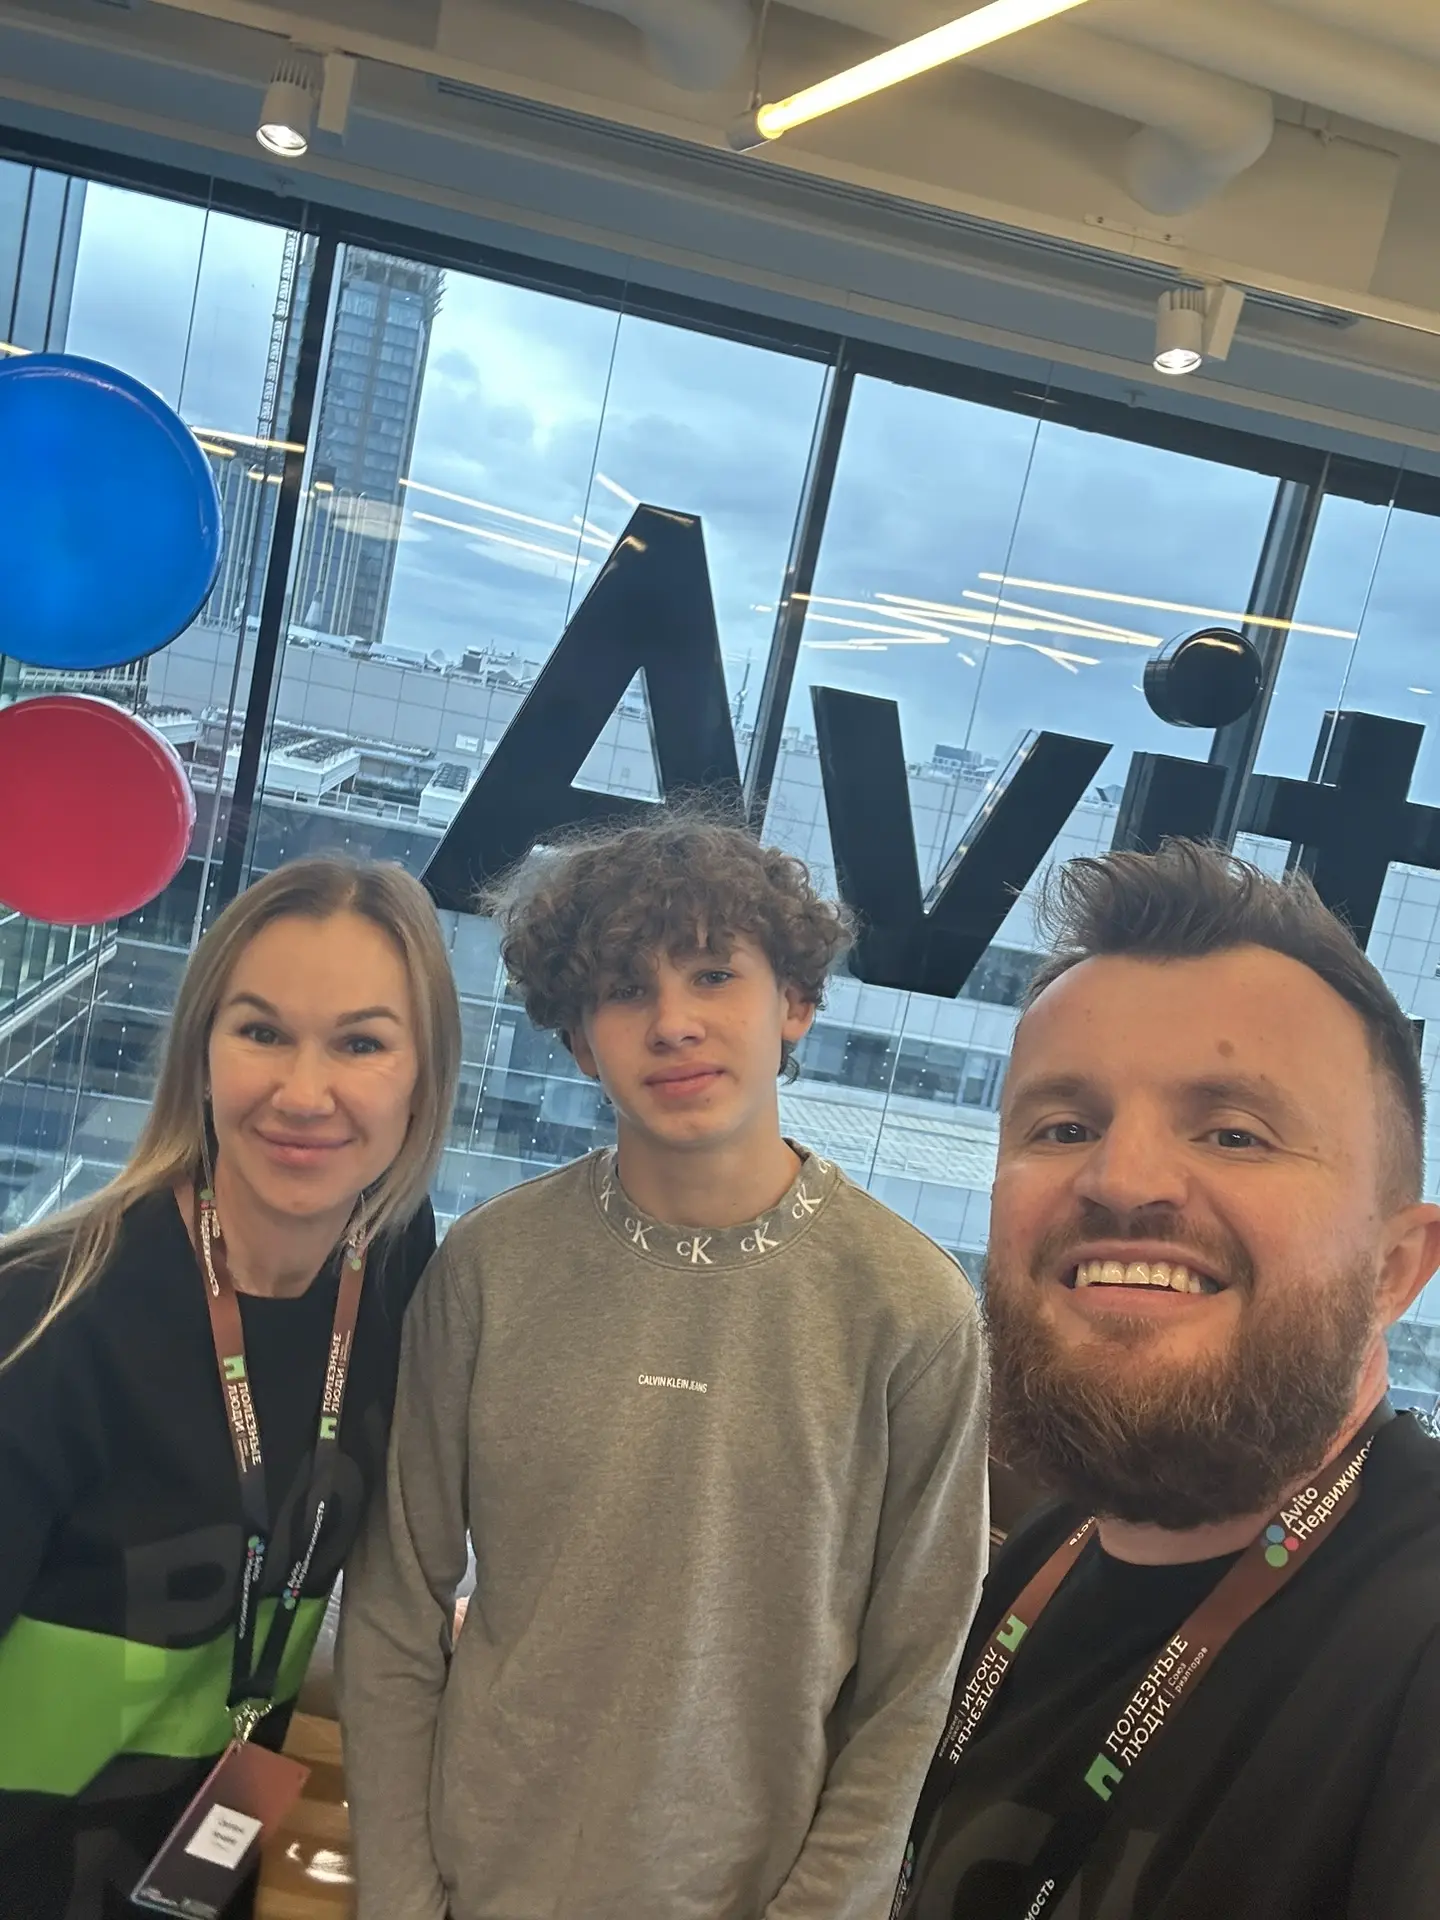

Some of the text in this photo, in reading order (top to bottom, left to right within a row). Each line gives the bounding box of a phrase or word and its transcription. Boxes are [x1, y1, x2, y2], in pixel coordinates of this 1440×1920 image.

[638, 1373, 667, 1388] CALVIN
[666, 1376, 689, 1390] KLEIN
[1279, 1486, 1319, 1529] Avito
[1291, 1435, 1375, 1541] Недвижимо
[949, 1655, 1009, 1765] ПОЛЕЗНЫЕ
[961, 1646, 998, 1711] ЛЮДИ
[1105, 1634, 1189, 1753] ПОЛЕЗНЫЕ
[1120, 1694, 1172, 1767] ЛЮДИ
